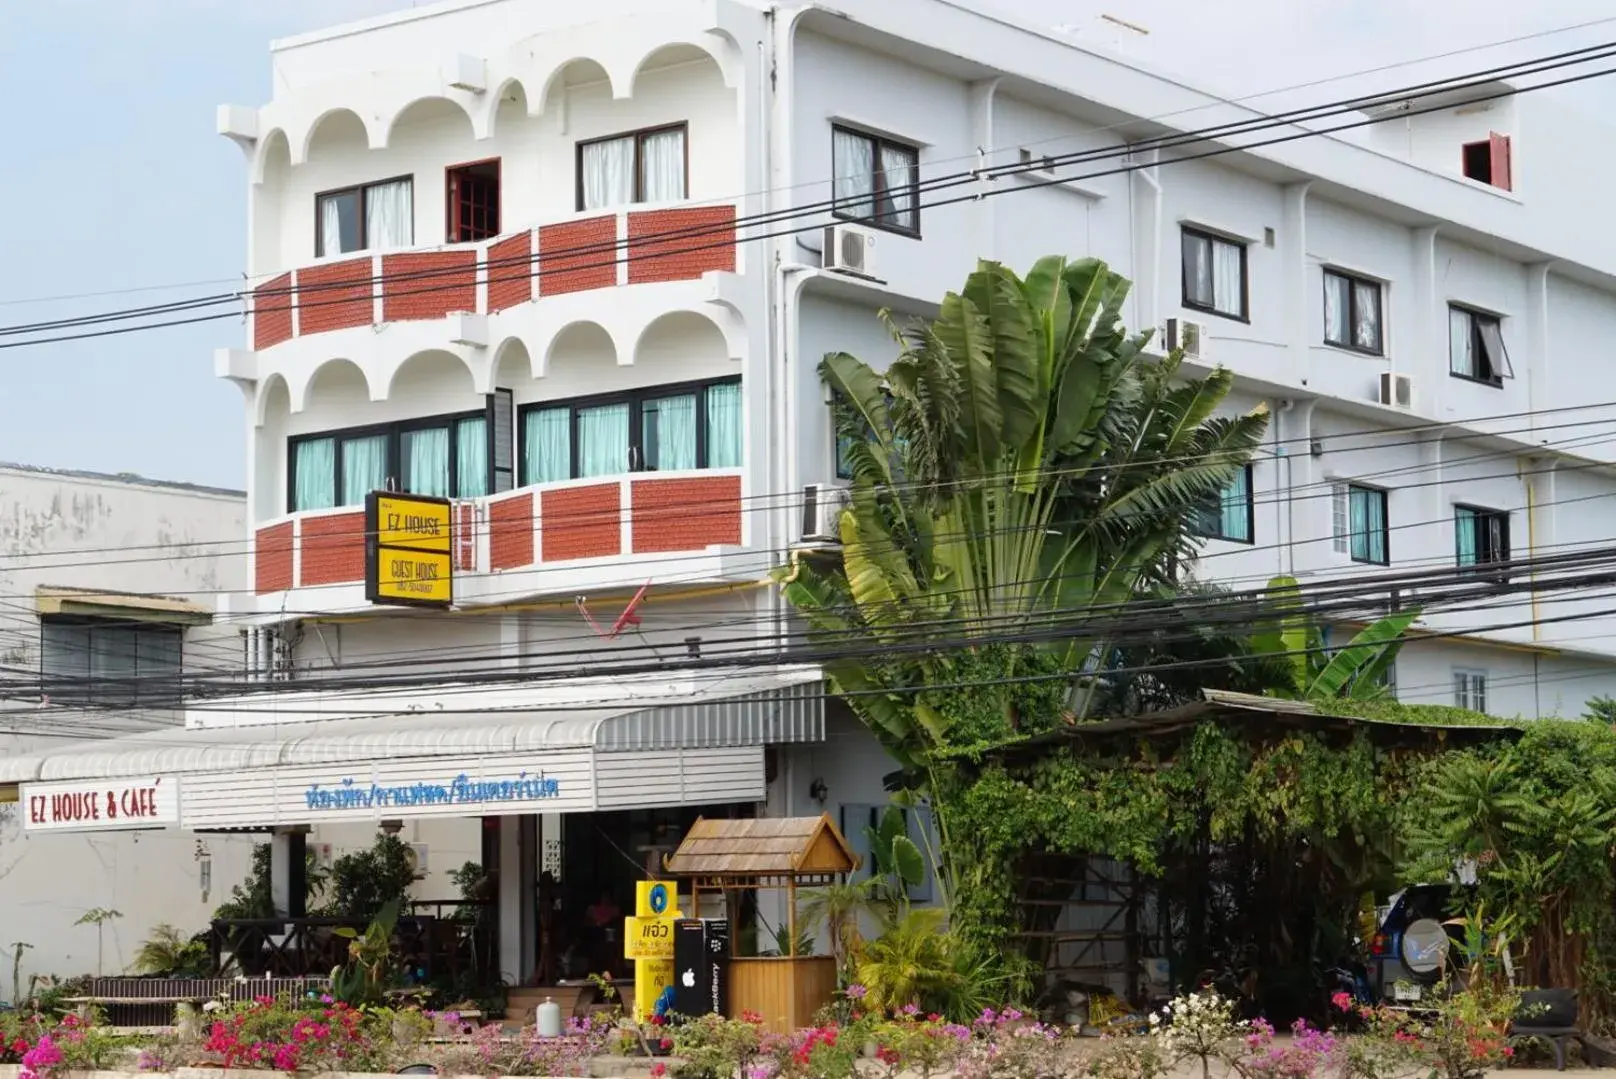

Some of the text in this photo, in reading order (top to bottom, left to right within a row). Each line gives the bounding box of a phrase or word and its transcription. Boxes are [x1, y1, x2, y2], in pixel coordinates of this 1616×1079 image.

[387, 512, 441, 536] EZ HOUSE
[391, 559, 440, 581] GUEST HOUSE
[31, 777, 161, 824] EZ HOUSE & CAFÉ
[711, 962, 721, 1015] ackBerry
